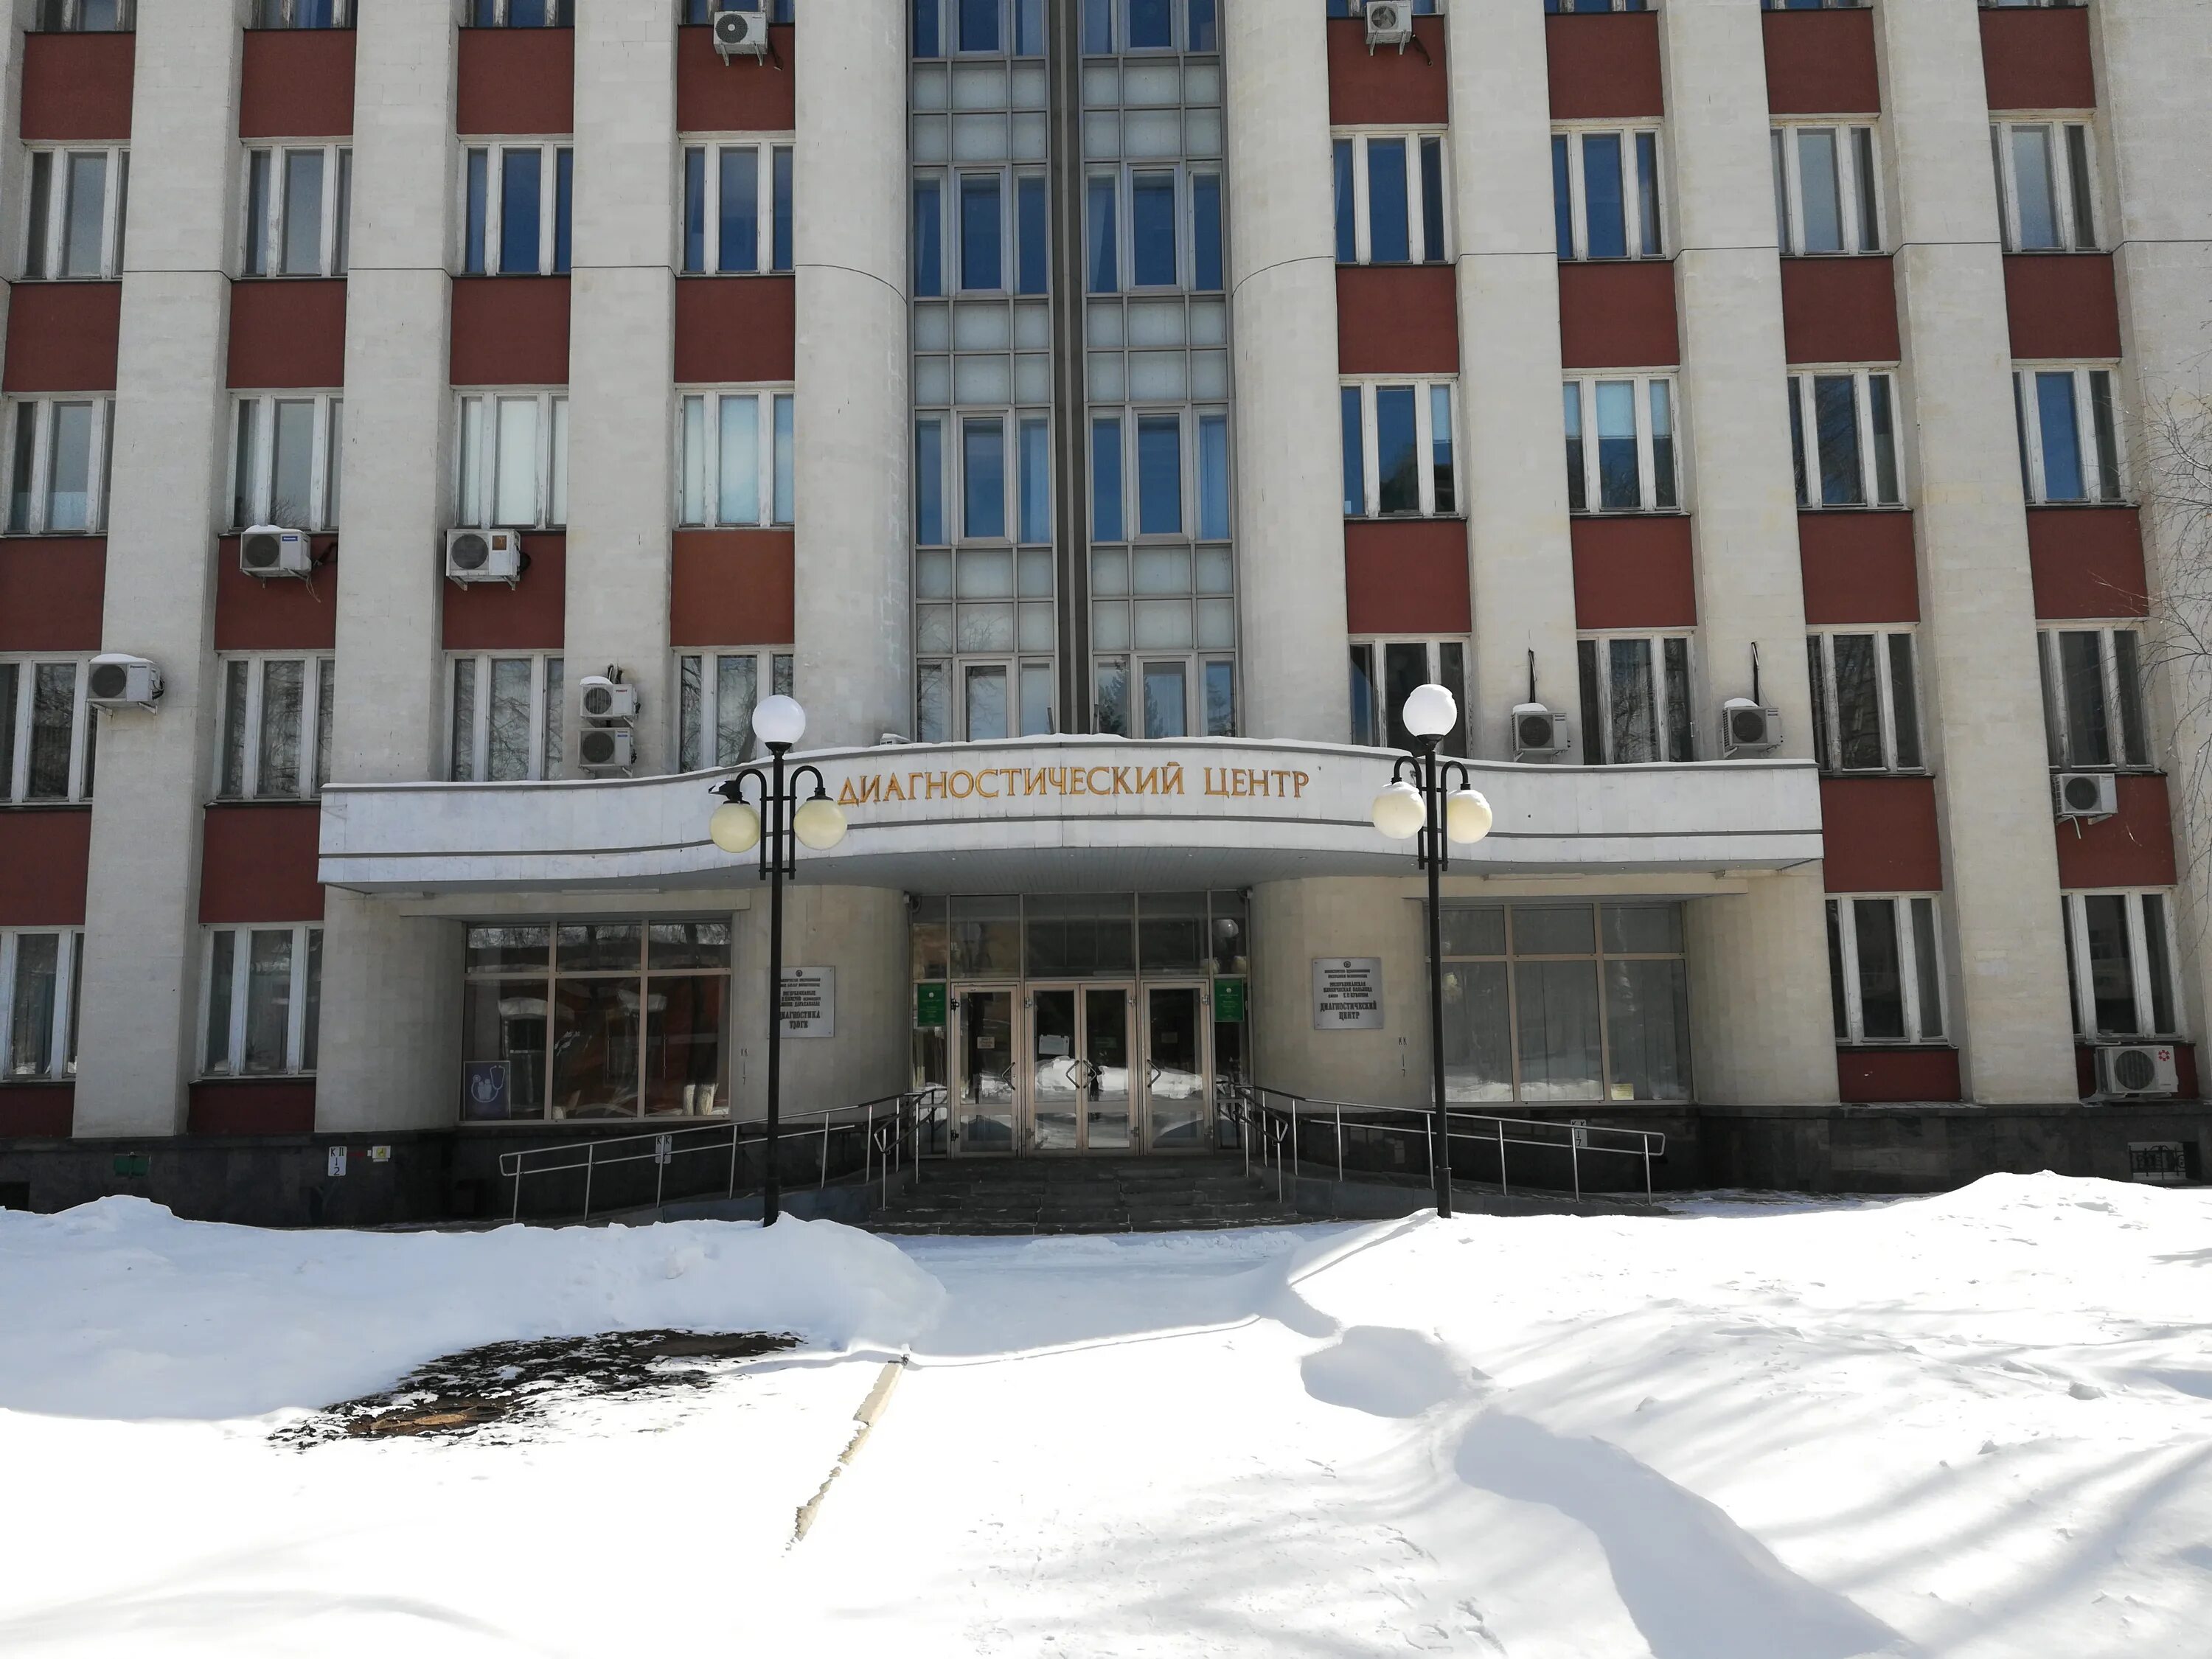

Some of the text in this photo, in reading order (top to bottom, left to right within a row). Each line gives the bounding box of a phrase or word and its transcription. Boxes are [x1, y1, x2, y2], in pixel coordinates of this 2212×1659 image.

[838, 762, 1310, 806] ДИАГНОСТИЧЕСКИЙ ЦЕНТР
[1339, 1012, 1360, 1020] ЦЕНТР
[333, 1166, 340, 1175] 2
